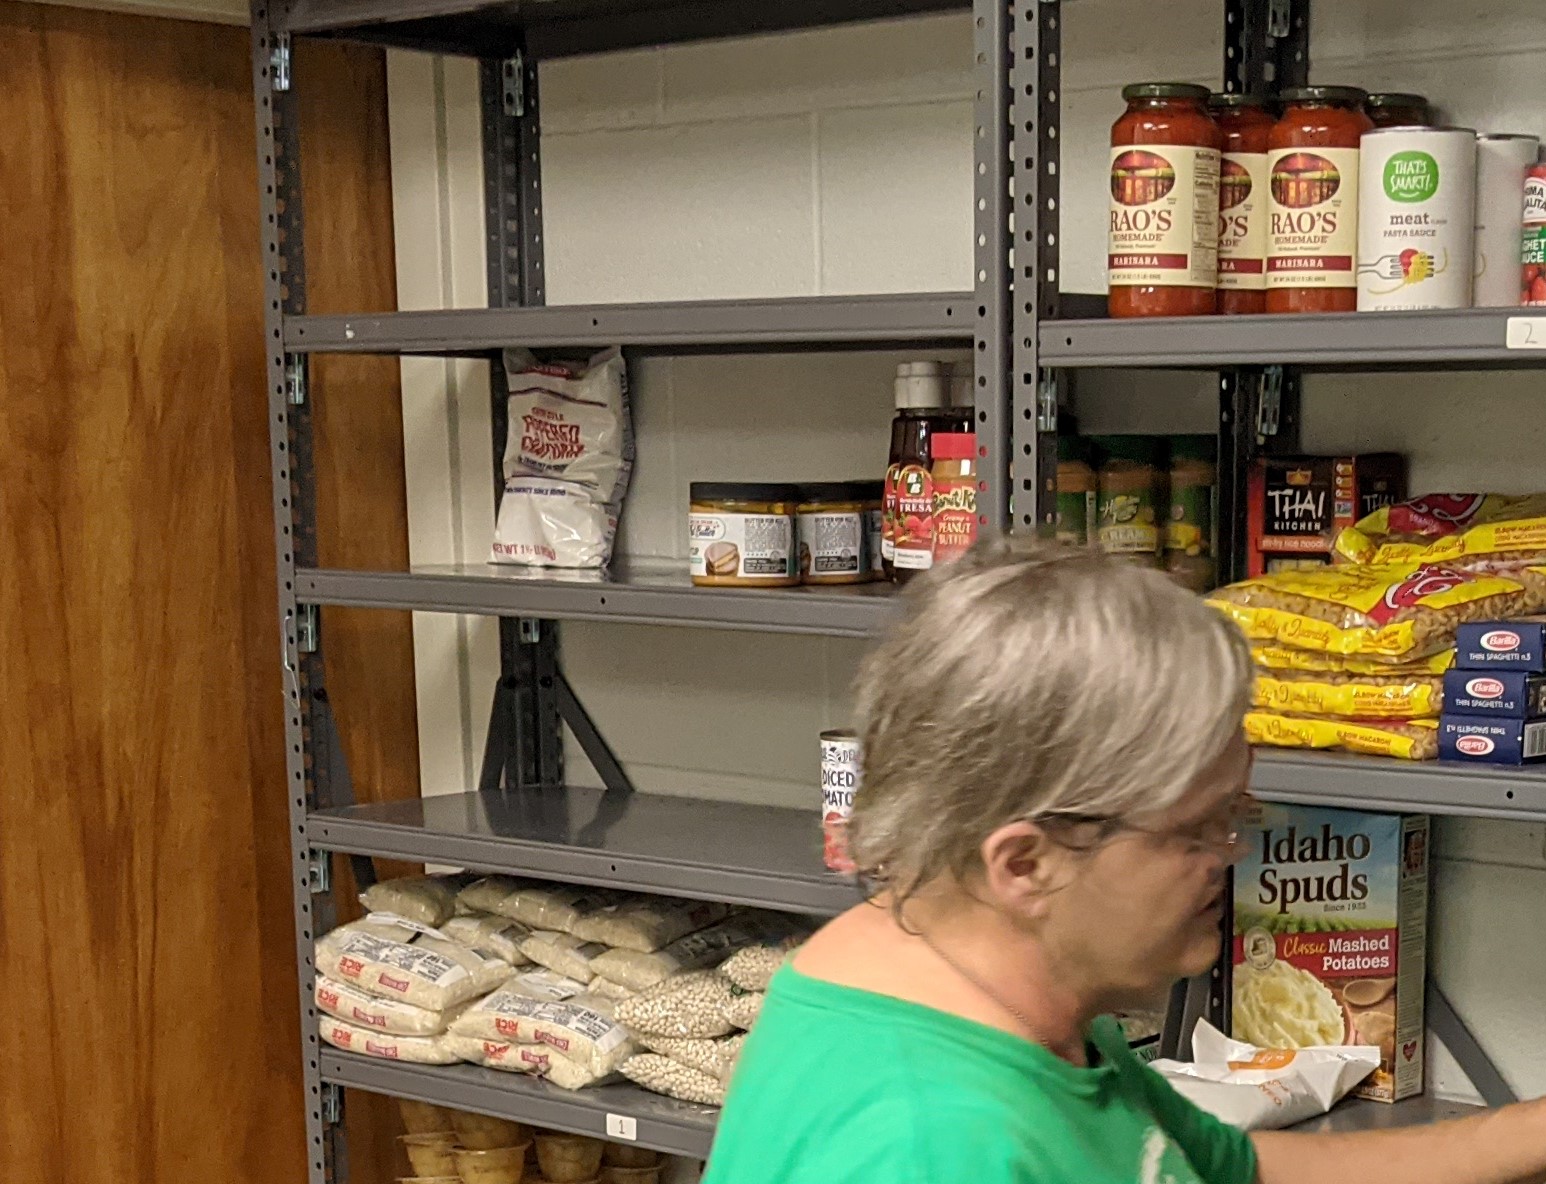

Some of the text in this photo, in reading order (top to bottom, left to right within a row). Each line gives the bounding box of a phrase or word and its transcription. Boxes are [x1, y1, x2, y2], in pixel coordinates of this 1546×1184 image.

[1393, 160, 1427, 174] THAT'S
[1391, 174, 1430, 193] SMART!
[1110, 209, 1172, 232] RAO'S
[1218, 215, 1248, 237] O'S
[1271, 211, 1337, 235] RAO'S
[1390, 213, 1430, 225] meat
[1383, 229, 1408, 238] PASTA
[1523, 322, 1538, 344] 2
[1267, 488, 1325, 520] THAI
[938, 521, 972, 534] PEANUT
[1274, 521, 1320, 531] KITCHEN
[1488, 636, 1518, 645] Barilla
[1486, 652, 1520, 661] SPAGHETTI
[1472, 683, 1502, 693] Barilla
[1471, 700, 1504, 708] SPAGHETTI
[822, 771, 855, 788] DICED
[1261, 824, 1371, 865] Idaho
[1258, 863, 1369, 914] Spuds
[1283, 935, 1389, 958] Classic Mashed
[1323, 955, 1389, 972] Potatoes
[618, 1119, 625, 1135] 1
